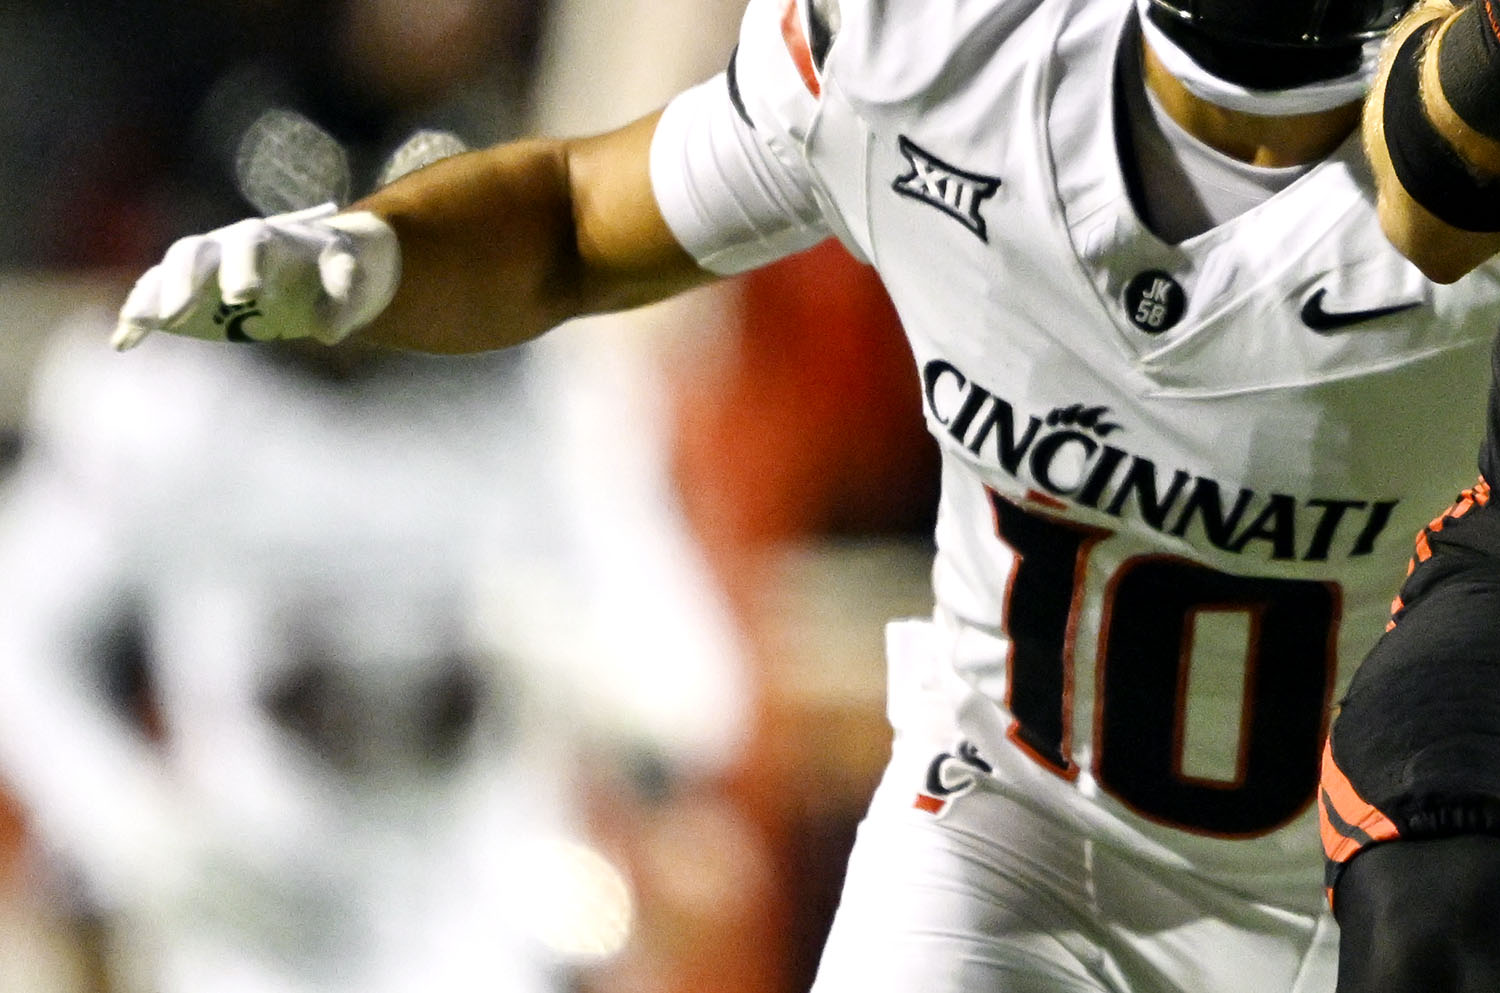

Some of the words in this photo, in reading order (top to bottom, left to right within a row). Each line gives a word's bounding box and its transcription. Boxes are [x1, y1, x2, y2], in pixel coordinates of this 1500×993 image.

[1142, 278, 1172, 305] JK
[923, 358, 1399, 562] CINCINNATI
[984, 483, 1343, 840] 10
